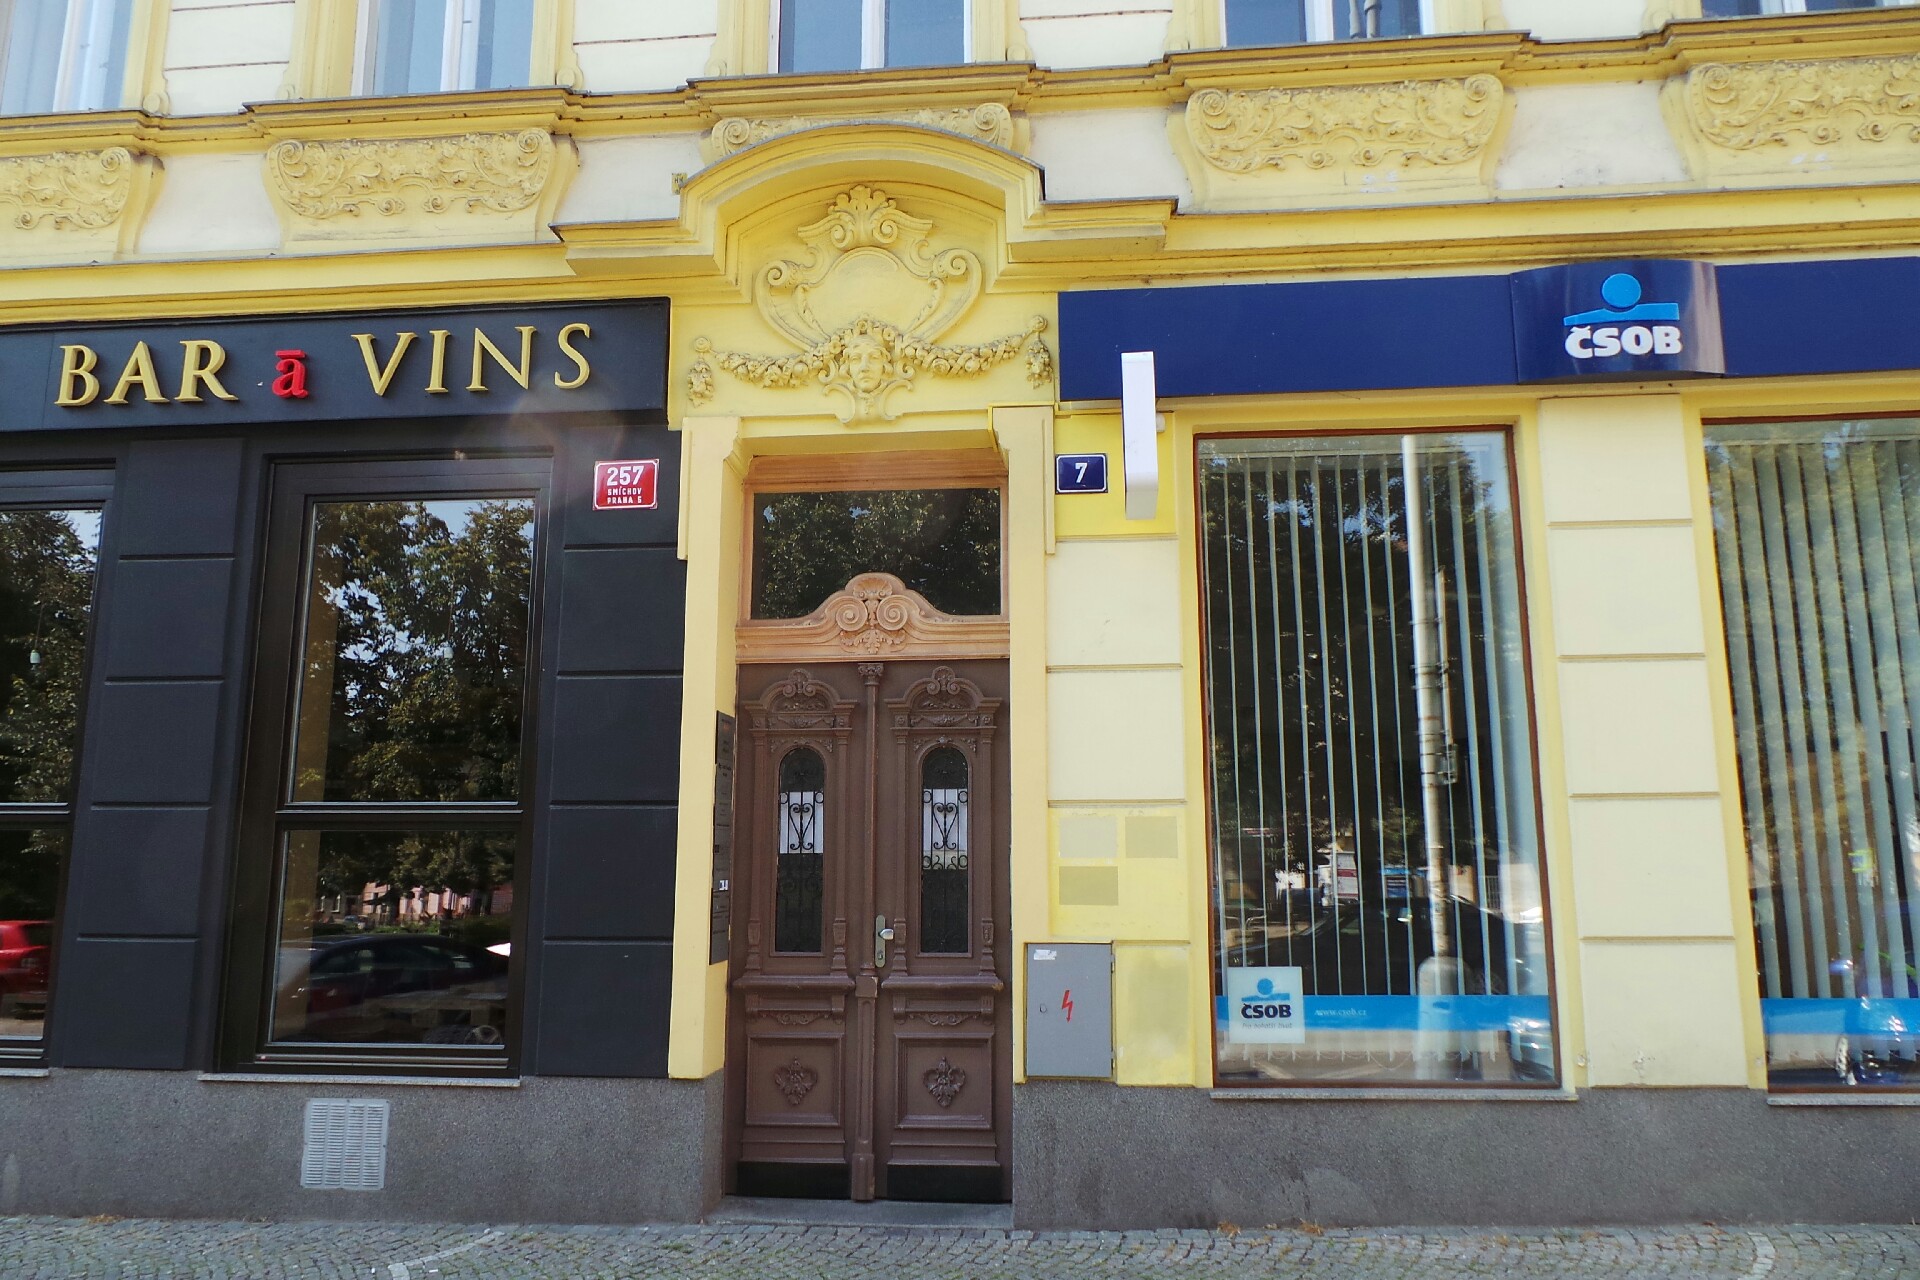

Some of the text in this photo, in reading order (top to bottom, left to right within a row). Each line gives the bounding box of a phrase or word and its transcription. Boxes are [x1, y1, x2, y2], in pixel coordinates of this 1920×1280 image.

[1565, 325, 1683, 359] ČSOB
[54, 340, 239, 407] BAR
[351, 323, 591, 397] VINS
[607, 465, 644, 486] 257
[1075, 462, 1088, 483] 7
[607, 496, 642, 504] PRAHA 5
[608, 486, 642, 496] SMÍCHOV
[1241, 1003, 1292, 1019] ČSOB
